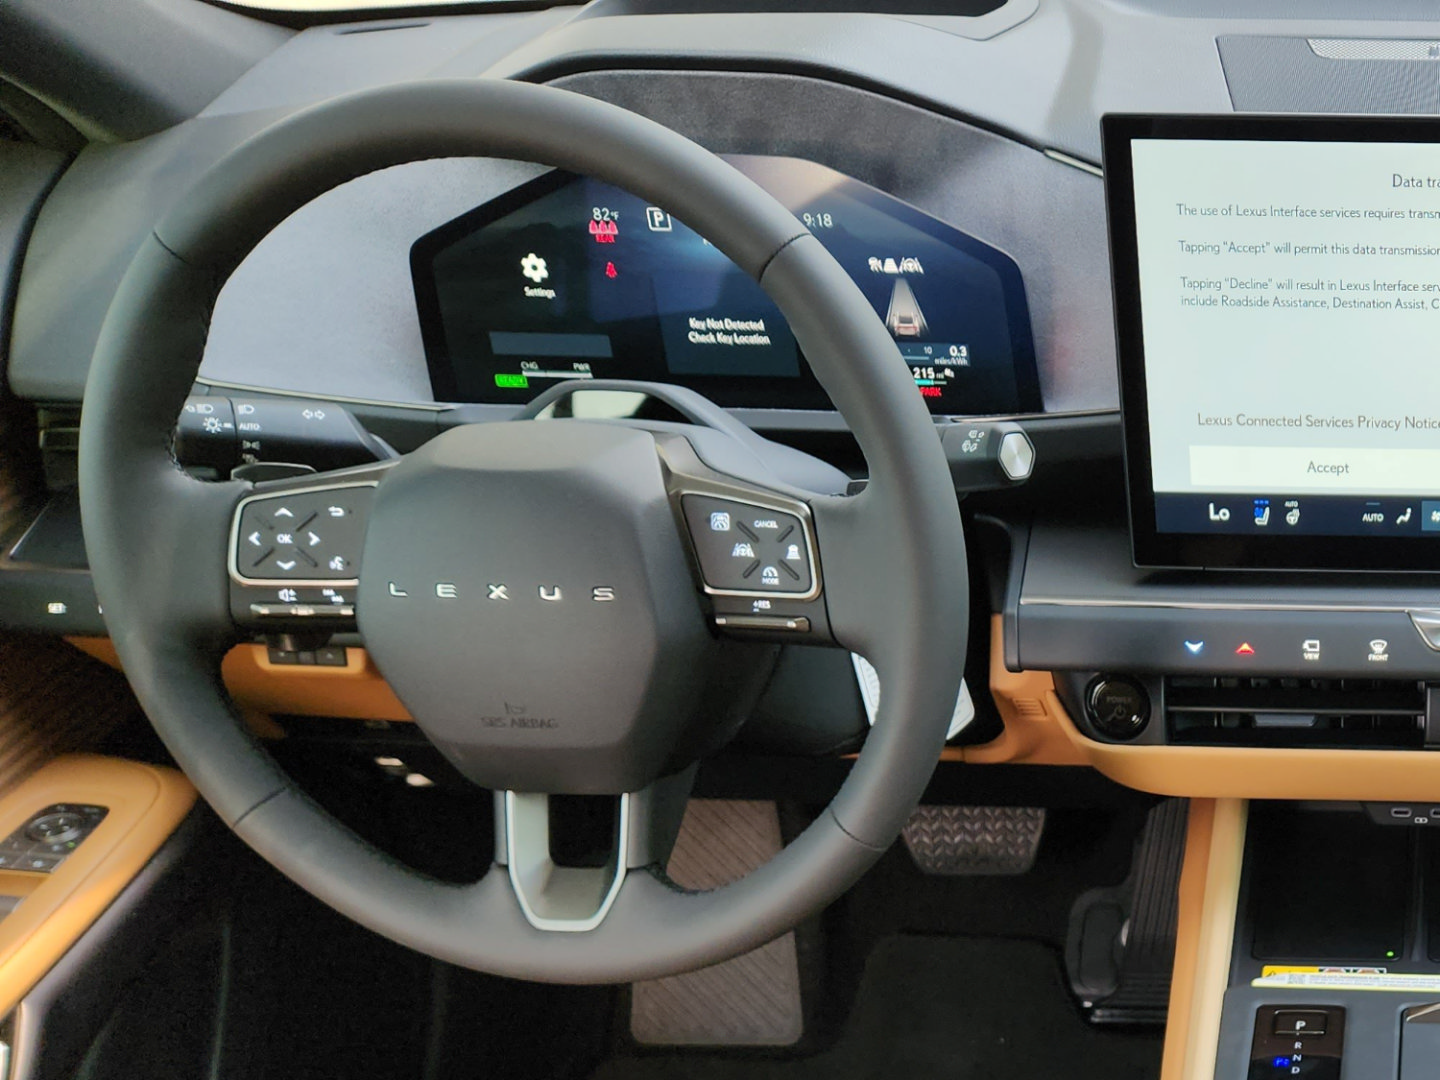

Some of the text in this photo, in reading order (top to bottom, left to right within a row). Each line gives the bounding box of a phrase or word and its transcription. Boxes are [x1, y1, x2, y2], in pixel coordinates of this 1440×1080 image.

[1392, 173, 1422, 188] Data
[1176, 204, 1197, 216] The
[1200, 207, 1218, 216] use
[1221, 204, 1233, 216] of
[1236, 205, 1267, 217] Lexus
[1270, 205, 1317, 218] Interface
[1320, 207, 1361, 218] services
[1364, 208, 1405, 221] requires
[803, 213, 832, 228] 9:18
[1178, 240, 1220, 255] Tapping
[1223, 241, 1270, 256] "Accept"
[1274, 242, 1291, 254] will
[1294, 243, 1327, 256] permit
[1331, 243, 1349, 255] this
[1352, 243, 1376, 255] data
[1181, 276, 1222, 291] Tapping
[1225, 278, 1273, 290] "Decline"
[1276, 279, 1293, 291] will
[1296, 279, 1324, 291] result
[1328, 280, 1337, 291] in
[1340, 280, 1370, 291] Lexus
[1373, 280, 1419, 292] Interface
[524, 286, 556, 299] Settings
[1181, 296, 1218, 307] include
[1221, 296, 1270, 307] Roadside
[1272, 297, 1330, 310] Assistance,
[1333, 297, 1392, 309] Destination
[689, 317, 764, 331] Key Not Detected
[688, 332, 771, 346] Check Key Location
[950, 345, 967, 358] 0.3
[521, 362, 538, 370] CHG
[573, 362, 590, 371] PWR
[913, 367, 935, 379] 215
[239, 423, 261, 431] AUTO
[1198, 413, 1232, 426] Lexus
[1236, 414, 1302, 427] Connected
[1306, 415, 1353, 428] Services
[1358, 416, 1401, 431] Privacy
[1307, 461, 1349, 476] Accept
[1209, 503, 1230, 521] Lo
[1362, 513, 1384, 523] AUTO
[754, 520, 778, 529] CANCEL
[277, 534, 293, 544] OK
[389, 582, 615, 601] LEXUS
[1368, 654, 1389, 662] FRONT
[1295, 1020, 1306, 1031] P
[1294, 1041, 1303, 1049] R
[1292, 1054, 1302, 1062] N
[1291, 1066, 1300, 1074] D
